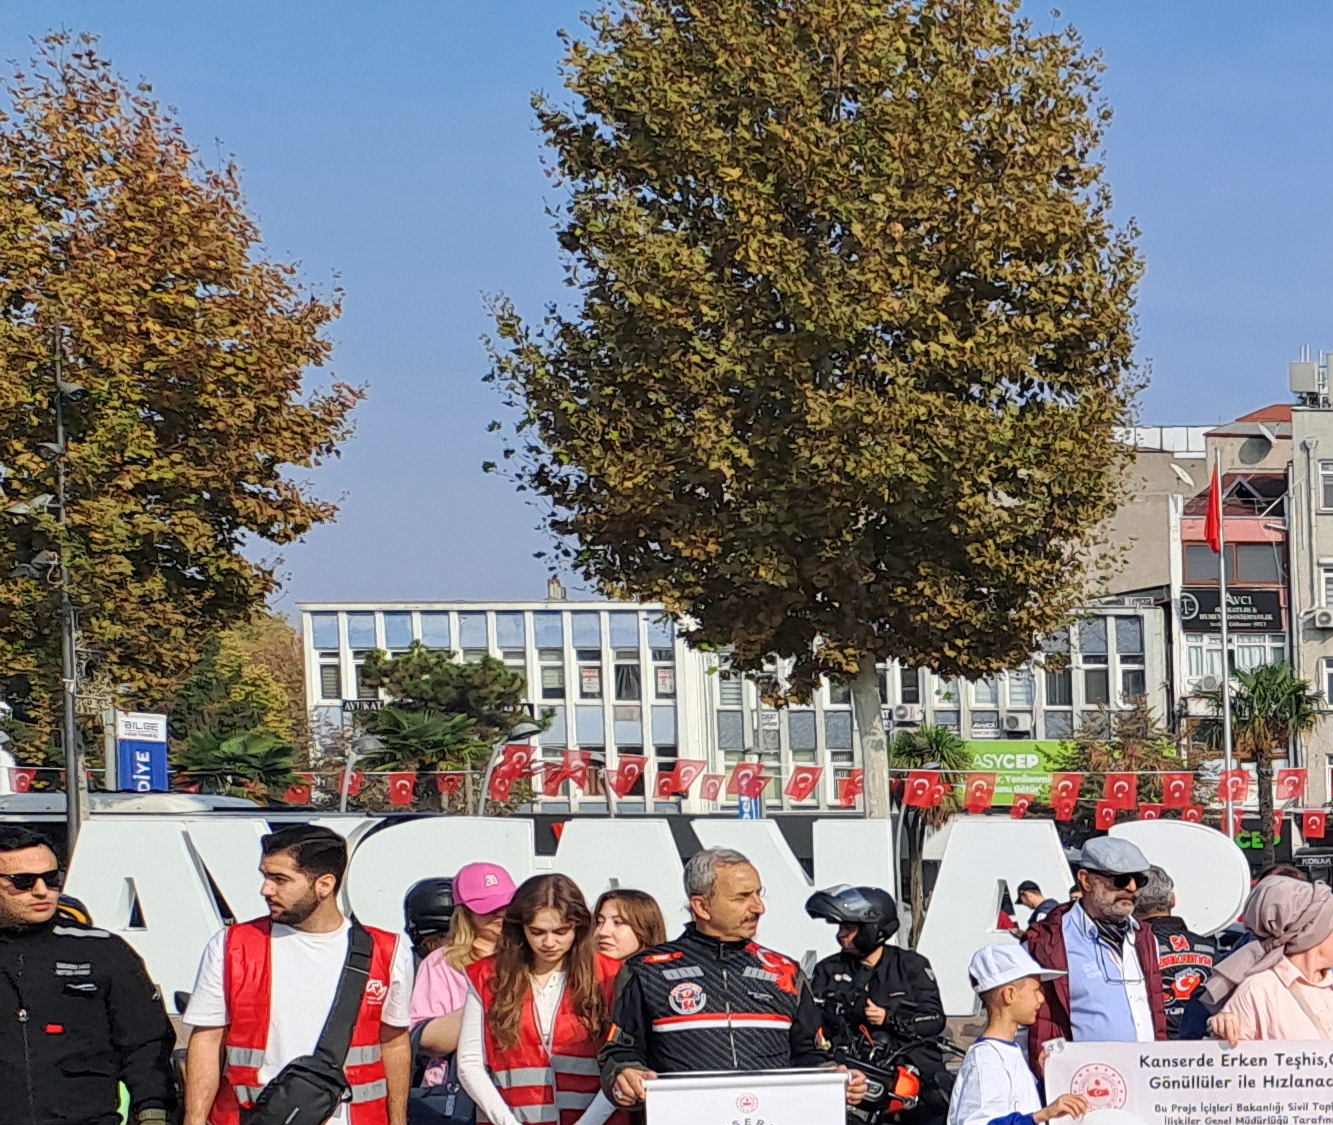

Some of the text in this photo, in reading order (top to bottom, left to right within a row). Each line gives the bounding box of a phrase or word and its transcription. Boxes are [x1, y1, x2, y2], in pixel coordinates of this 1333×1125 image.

[1139, 1053, 1216, 1069] Kanserde
[1221, 1053, 1266, 1068] Erken
[1149, 1074, 1232, 1091] Gönüllüler
[1237, 1074, 1256, 1089] ile
[1154, 1102, 1168, 1113] Bu
[1171, 1102, 1197, 1115] Proje
[1236, 1101, 1285, 1115] Bakanlığı
[1287, 1101, 1309, 1113] Sivil
[1205, 1115, 1232, 1125] Genel
